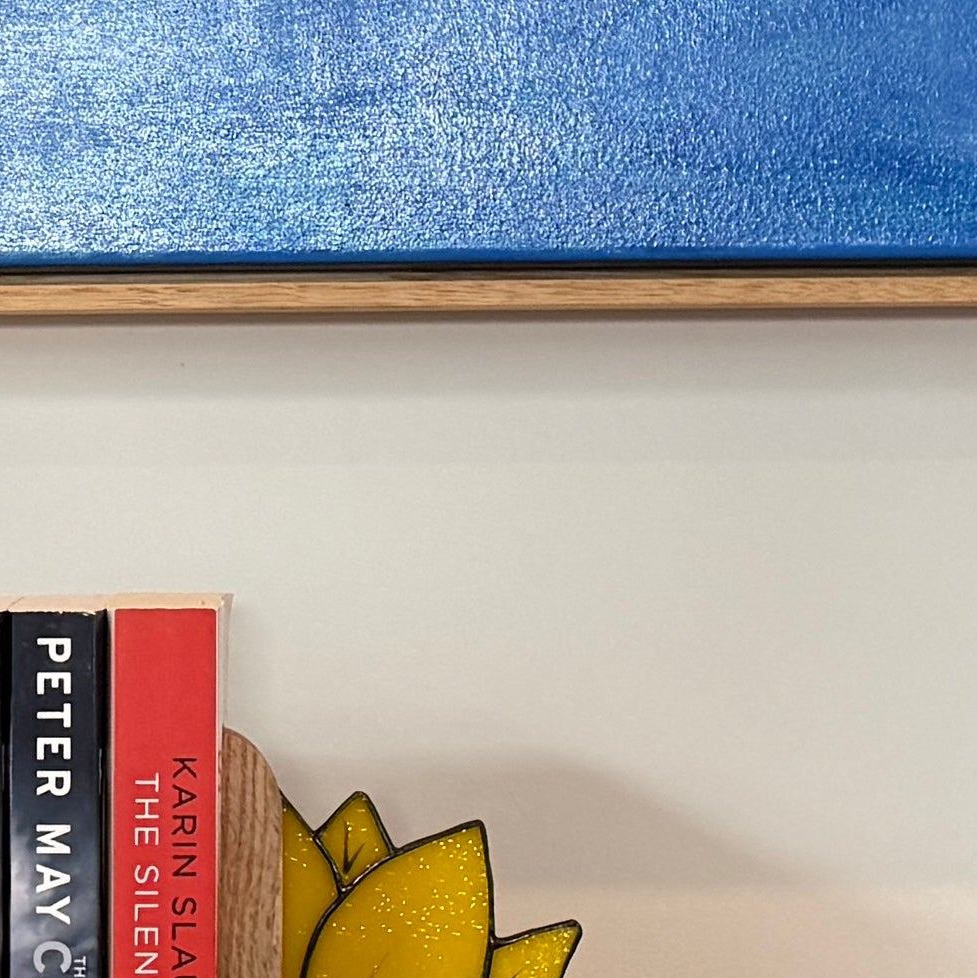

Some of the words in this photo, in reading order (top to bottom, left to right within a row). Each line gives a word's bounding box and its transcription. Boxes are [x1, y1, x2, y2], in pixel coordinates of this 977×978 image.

[35, 637, 72, 797] PETER
[134, 772, 160, 847] THE
[172, 756, 198, 878] KARIN
[35, 823, 72, 926] MAY
